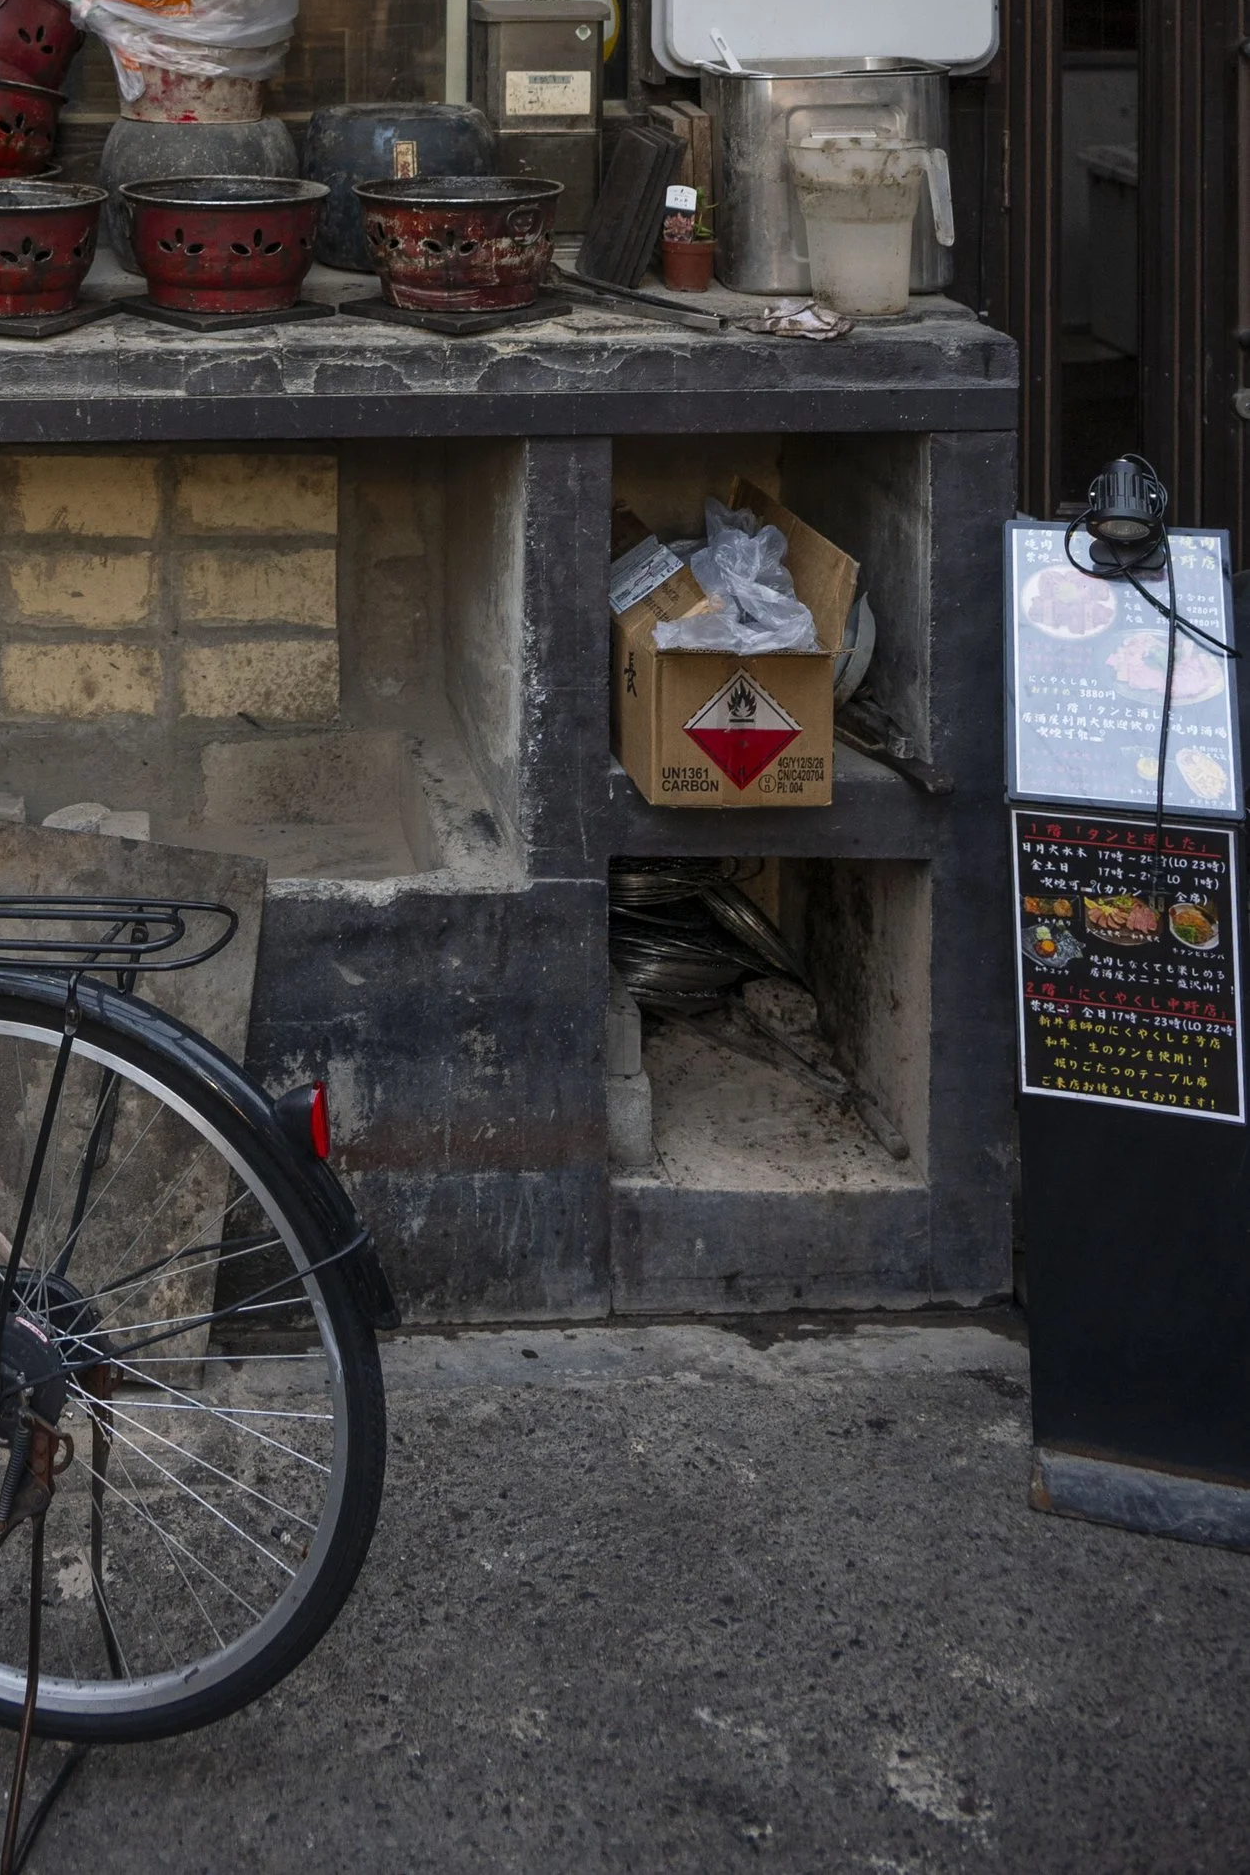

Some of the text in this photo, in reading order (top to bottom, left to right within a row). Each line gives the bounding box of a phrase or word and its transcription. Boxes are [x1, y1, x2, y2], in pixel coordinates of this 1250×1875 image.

[777, 757, 825, 769] 4G/Y12/S/26
[662, 767, 710, 779] UN1361
[661, 779, 720, 793] CARBON
[1030, 859, 1069, 873] 金土日
[1090, 954, 1225, 980] 焼肉しなくても楽しめる
